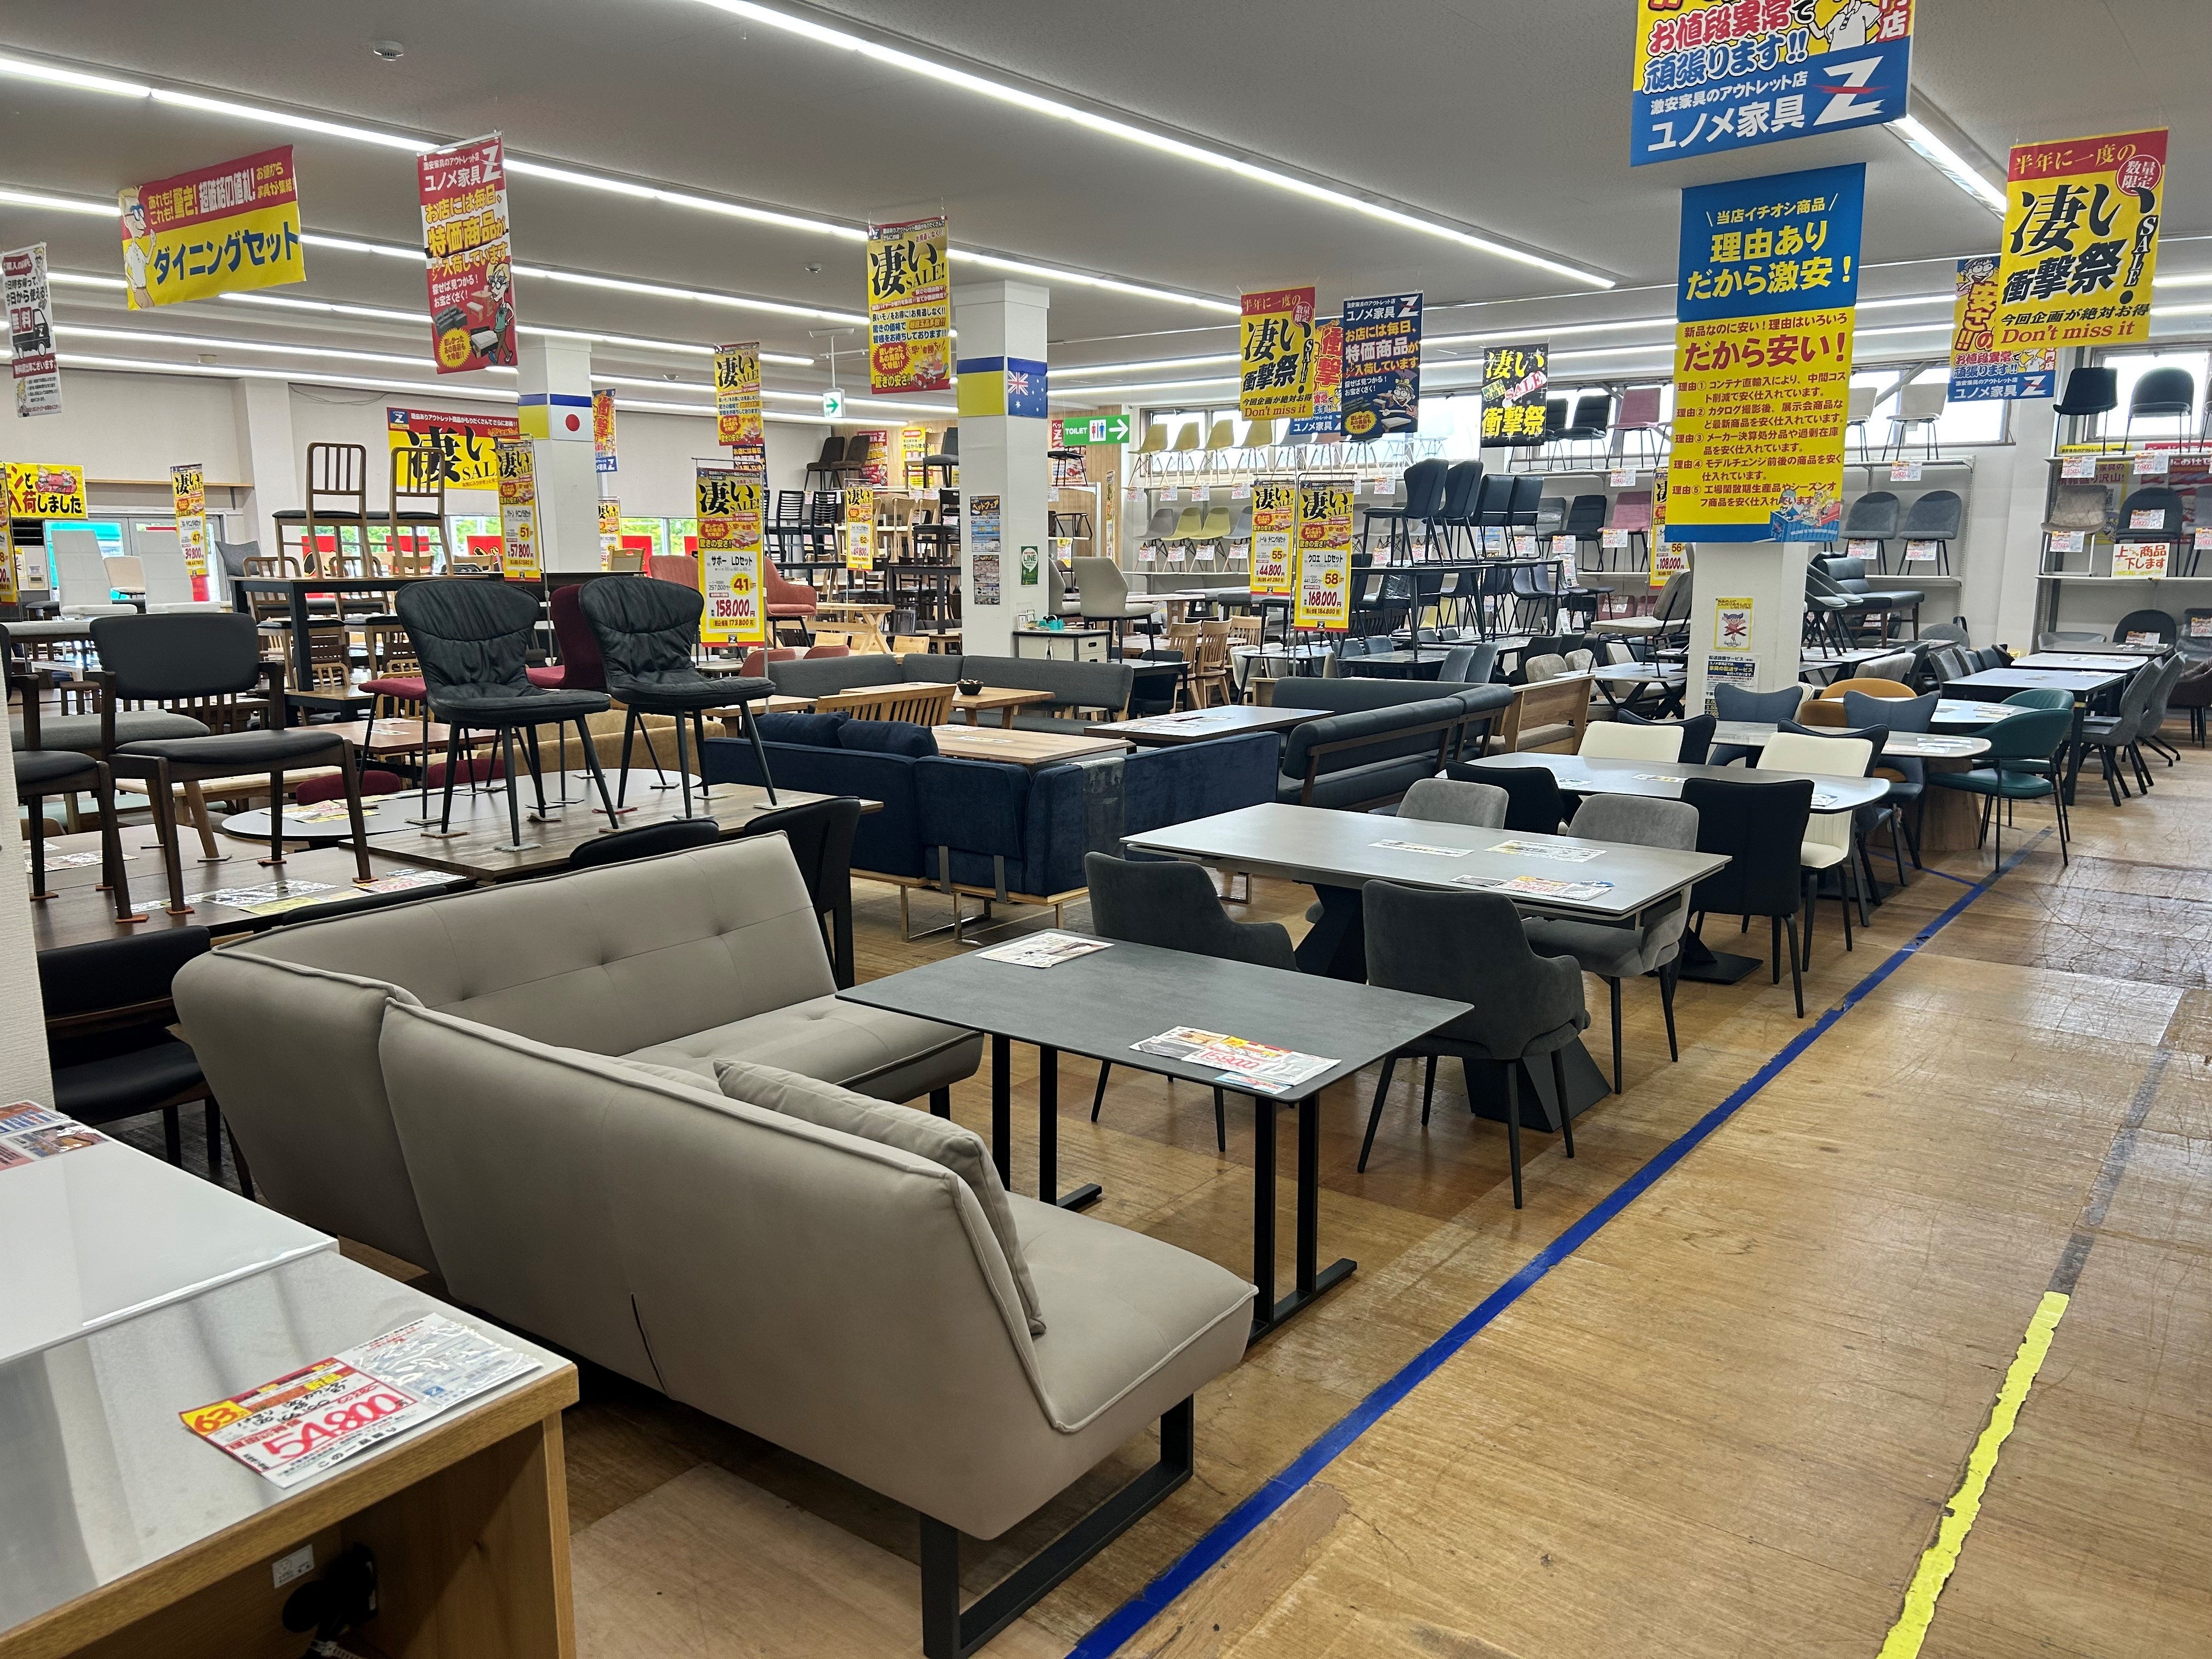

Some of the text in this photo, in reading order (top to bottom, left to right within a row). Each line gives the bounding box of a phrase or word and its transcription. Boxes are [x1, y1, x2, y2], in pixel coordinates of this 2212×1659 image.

[1647, 0, 1815, 54] お値段異常で
[1650, 71, 1808, 116] 激安家具のアウトレット店
[1647, 94, 1805, 152] ユノメ家具
[2014, 143, 2136, 174] 半年に一度の
[425, 165, 481, 192] ユノメ家具
[1717, 197, 1825, 225] 当店イチオシ商品
[2010, 183, 2156, 257] 凄い
[154, 221, 300, 285] ダイニングセット
[1709, 220, 1829, 263] 理由あり
[870, 240, 938, 300] 凄い
[906, 262, 945, 290] SALE!
[2001, 238, 2129, 305] 衝撃祭
[1243, 295, 1301, 312] 半年に一度の
[1346, 307, 1395, 322] ユノメ家具
[2000, 304, 2149, 326] 今回企画が絶対お得
[1244, 318, 1312, 363] 凄い
[2001, 320, 2135, 345] Don't miss it
[1345, 336, 1419, 364] 特価商品が
[716, 354, 754, 390] 凄い
[1242, 353, 1299, 393] 衝撃祭
[1486, 349, 1545, 380] 凄い
[1505, 372, 1544, 400] SALE
[1954, 385, 2018, 399] ユノメ家具
[1244, 403, 1306, 417] Don't miss it
[1481, 405, 1547, 437] 衝撃祭
[1065, 427, 1088, 435] TOILET
[1293, 419, 1333, 432] ユノメ家具
[698, 481, 754, 516] 凄い
[730, 499, 760, 513] SALE!
[1255, 487, 1290, 510] 凄い
[1302, 489, 1348, 521] 凄い
[520, 528, 530, 538] 51
[1272, 550, 1283, 560] 55
[1308, 554, 1321, 563] クロエ
[1672, 543, 1682, 552] 56
[2125, 557, 2166, 570] 下します
[733, 578, 749, 591] 41
[1324, 573, 1339, 585] 58
[194, 1408, 239, 1433] 63
